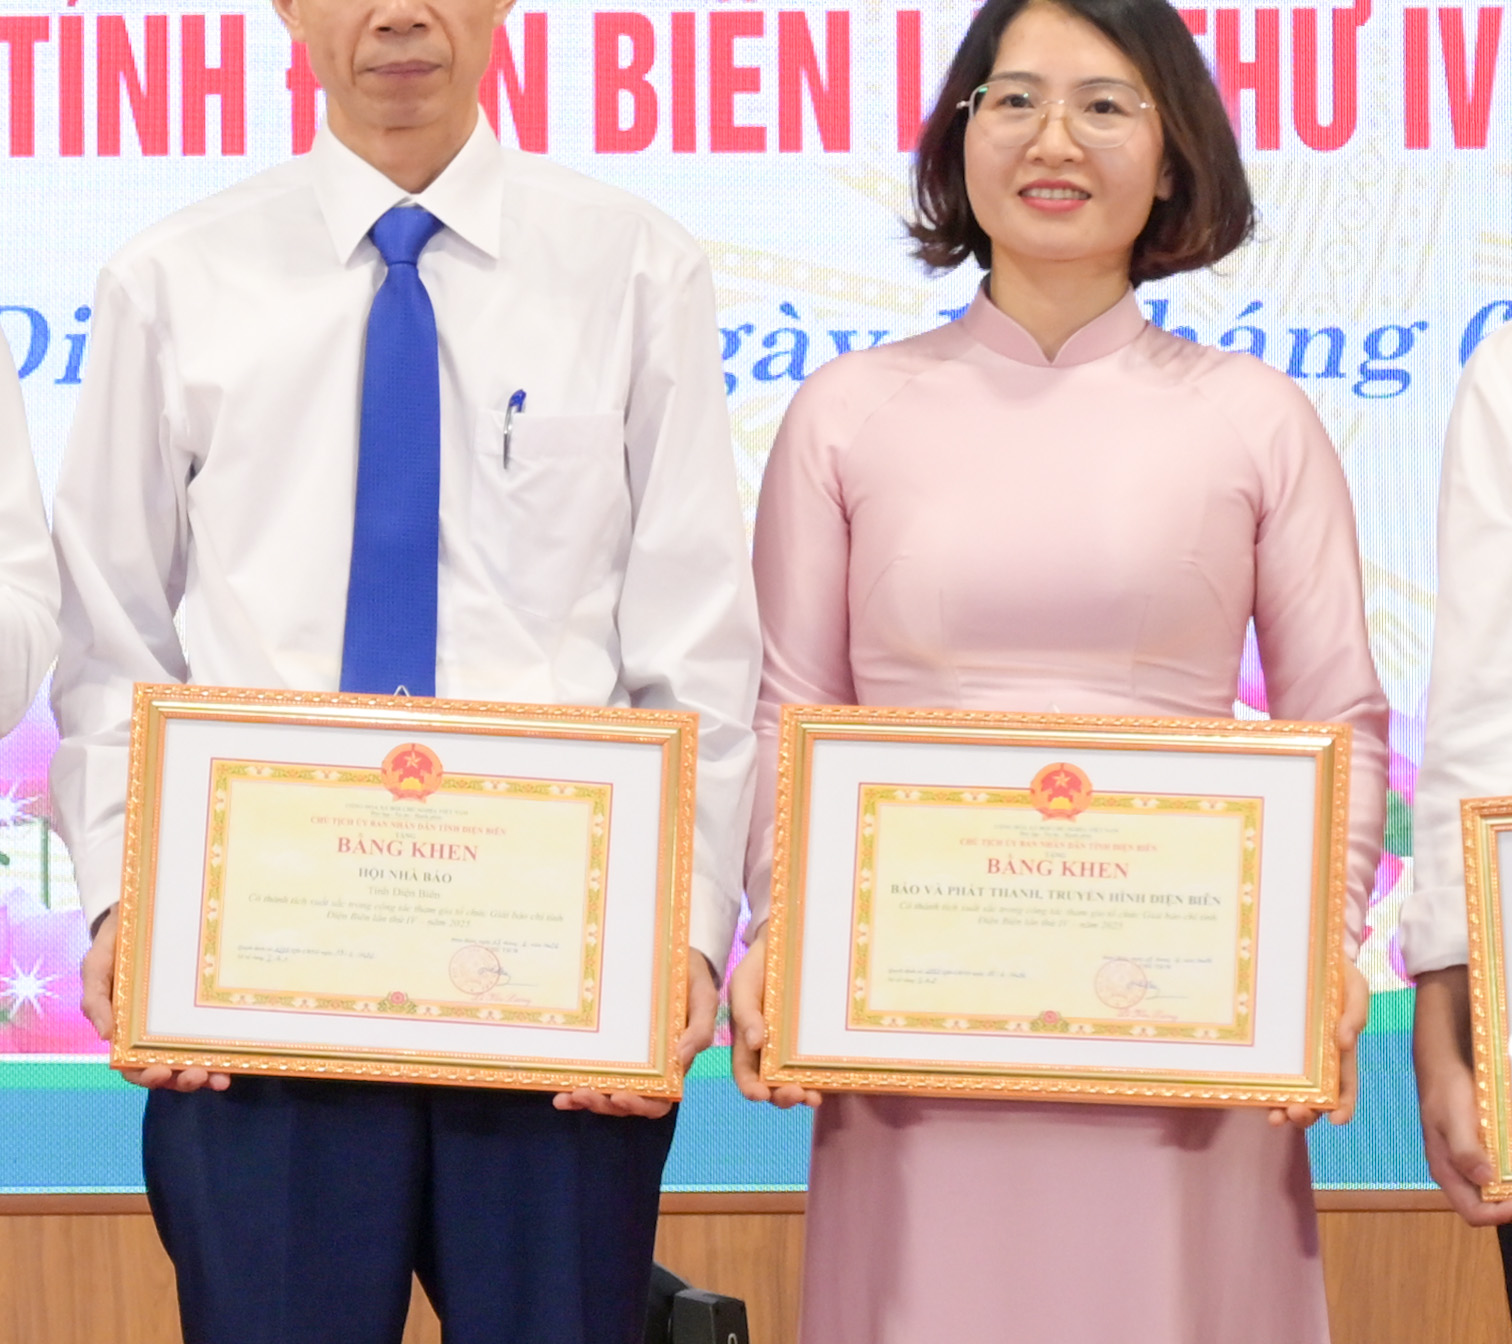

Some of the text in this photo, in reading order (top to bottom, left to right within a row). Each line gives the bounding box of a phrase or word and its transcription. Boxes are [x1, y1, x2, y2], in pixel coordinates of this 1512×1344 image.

[1404, 5, 1503, 149] IV
[337, 833, 478, 862] BẰNG KHEN
[358, 867, 452, 883] HỘI NHÀ BÁO
[987, 853, 1129, 879] BẰNG KHEN
